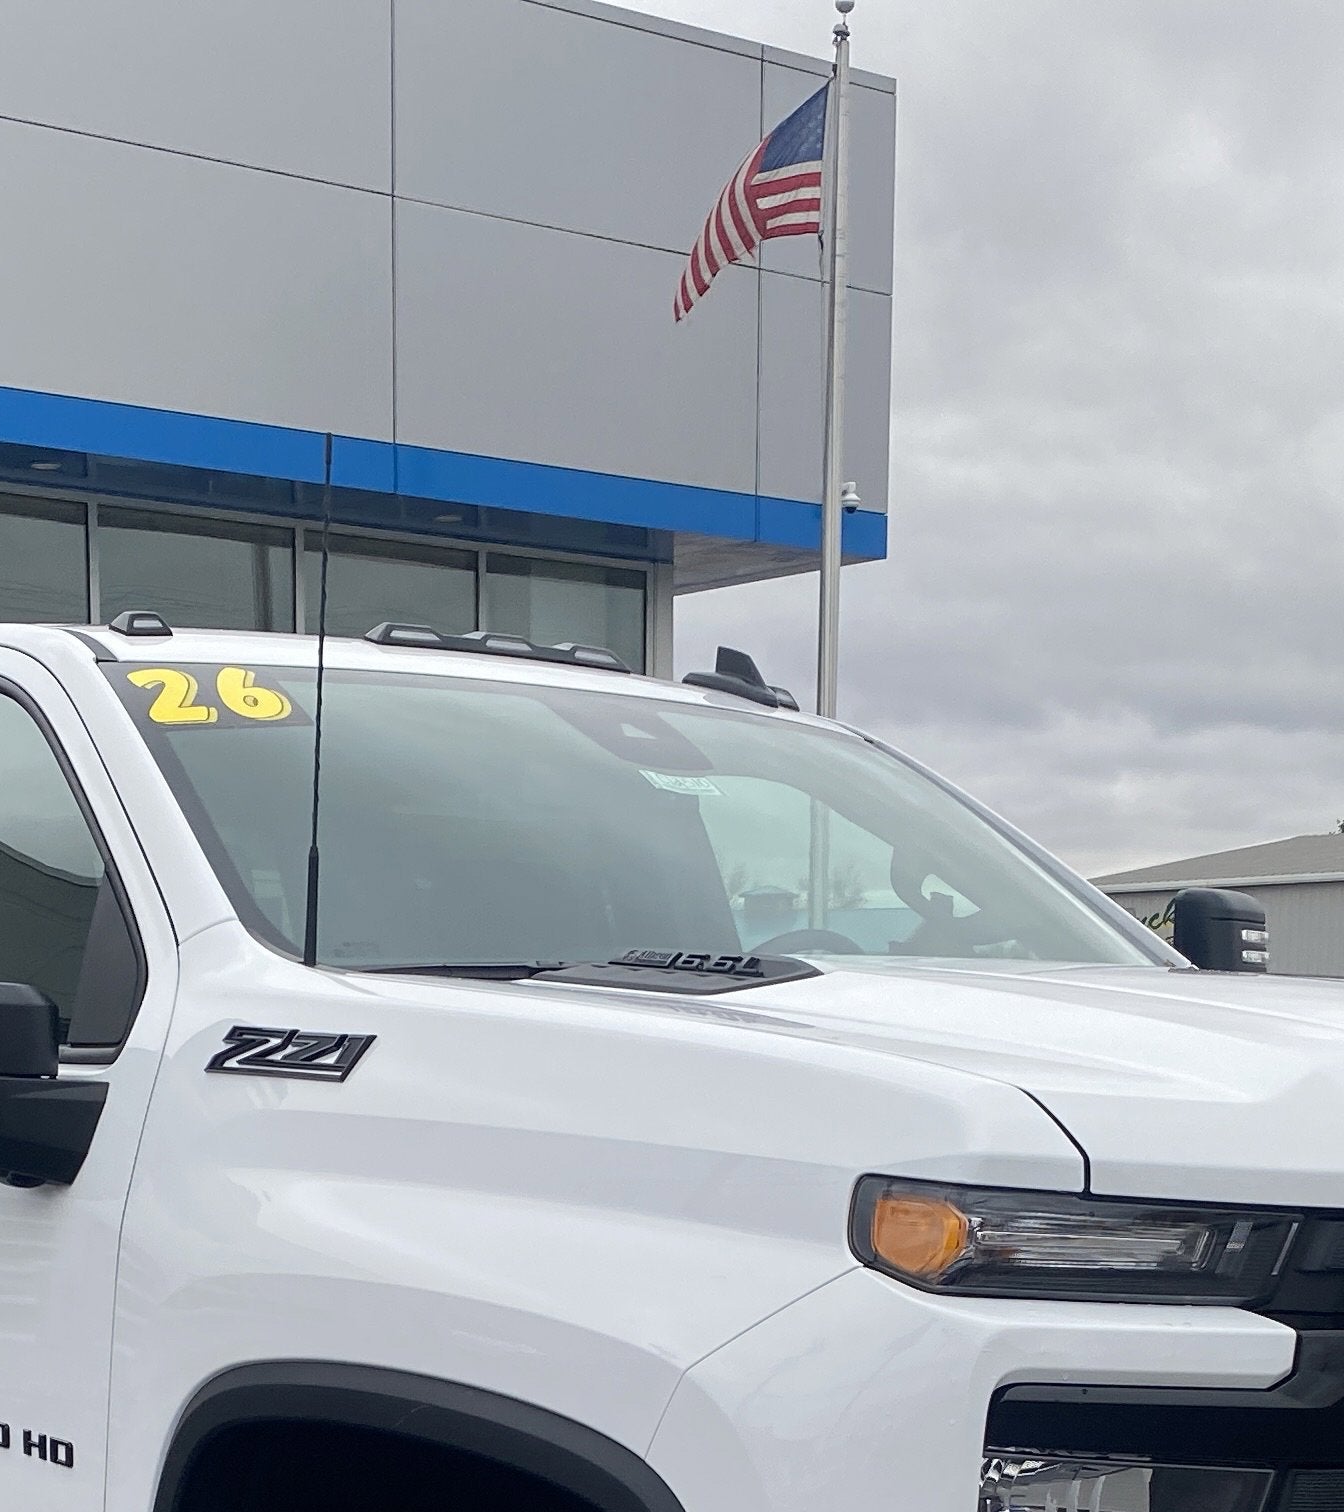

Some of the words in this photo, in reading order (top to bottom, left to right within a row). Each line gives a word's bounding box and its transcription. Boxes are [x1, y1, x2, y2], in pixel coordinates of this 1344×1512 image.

[126, 667, 292, 725] 26
[204, 1025, 377, 1083] Z71
[22, 1429, 74, 1468] HD
